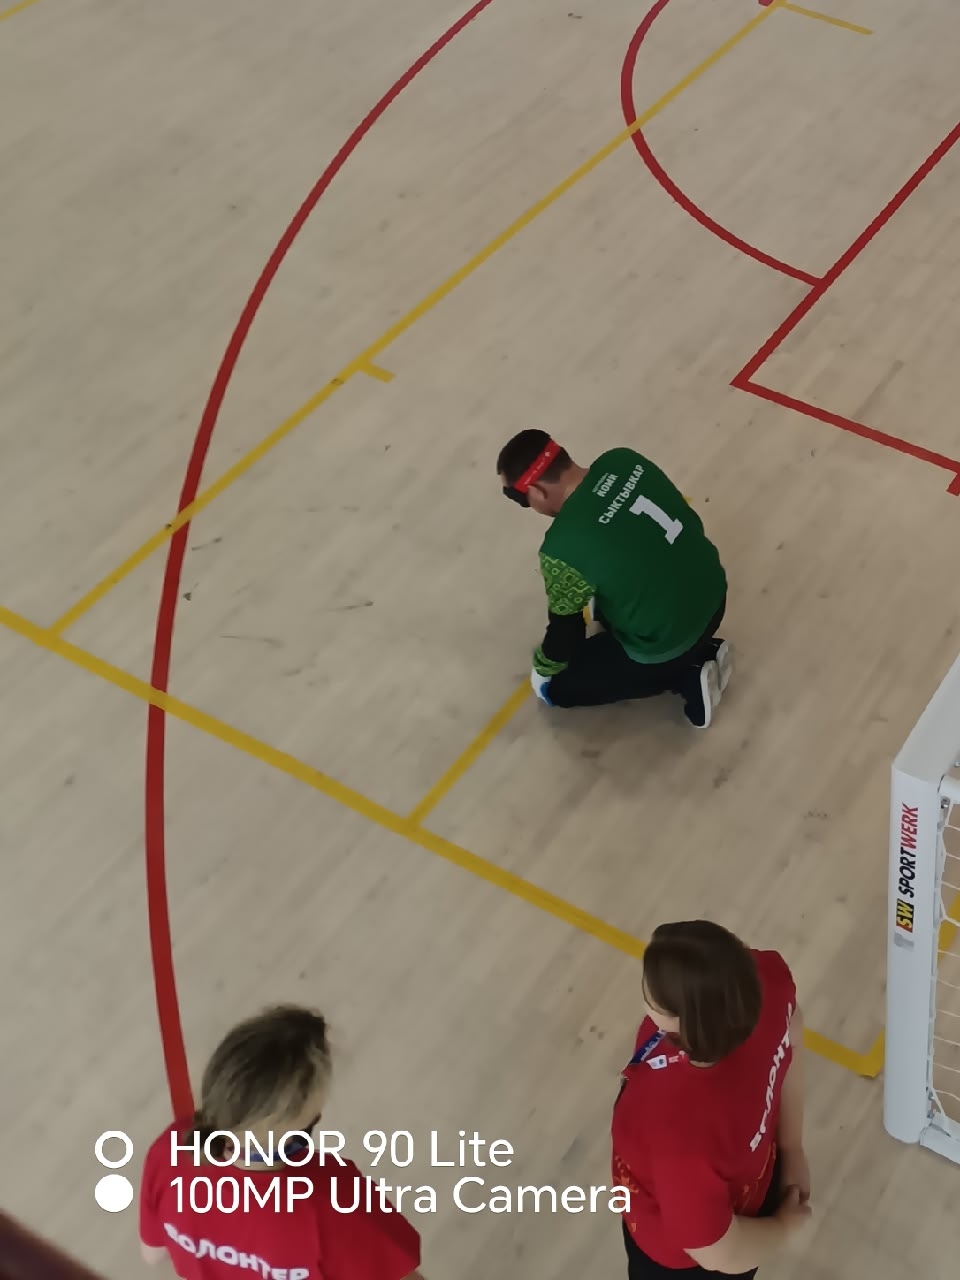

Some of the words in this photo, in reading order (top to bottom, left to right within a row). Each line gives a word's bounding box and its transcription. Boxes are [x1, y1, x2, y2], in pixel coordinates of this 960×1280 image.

[598, 464, 645, 524] СЫКТЫВКАР
[628, 494, 684, 545] 1
[898, 802, 919, 898] SPORTWERK
